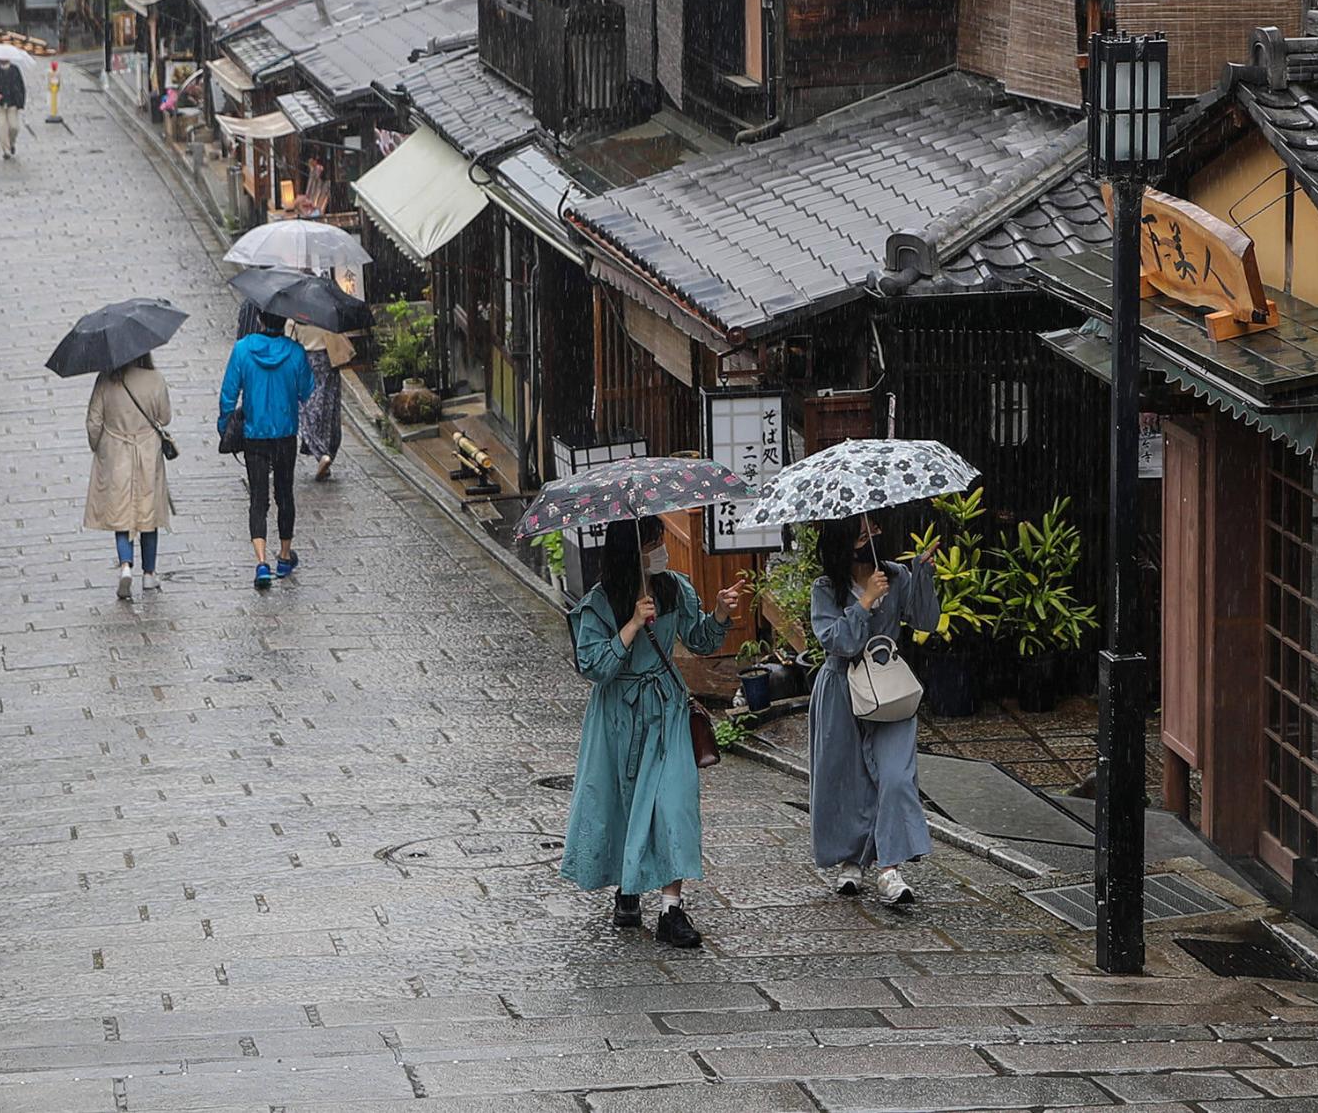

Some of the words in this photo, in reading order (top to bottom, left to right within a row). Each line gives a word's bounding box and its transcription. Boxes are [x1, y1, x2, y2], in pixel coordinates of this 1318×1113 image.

[762, 409, 779, 465] そば処
[743, 446, 758, 488] 二寧
